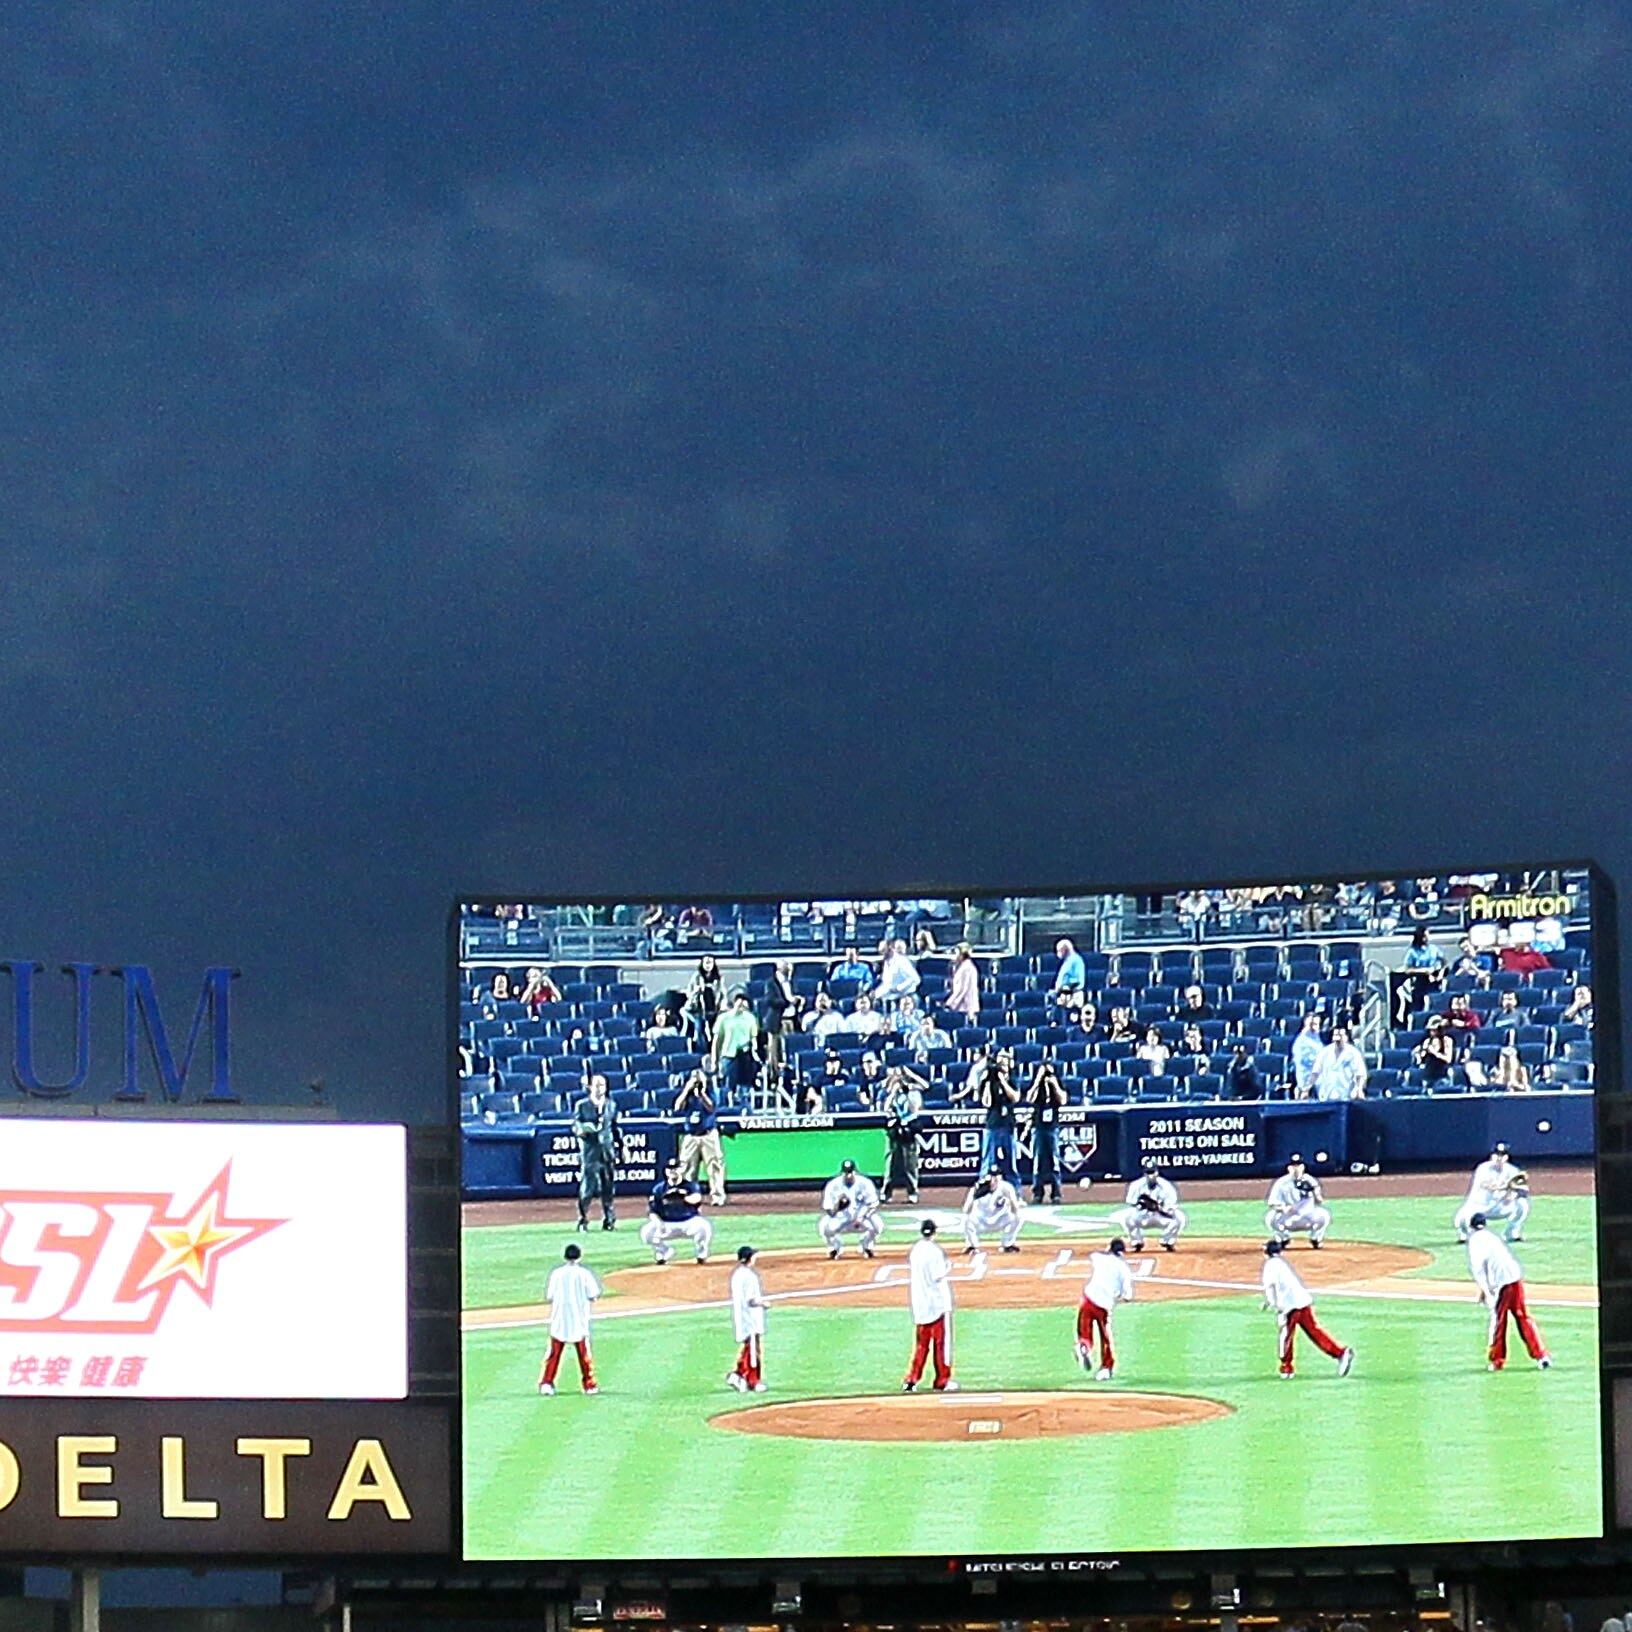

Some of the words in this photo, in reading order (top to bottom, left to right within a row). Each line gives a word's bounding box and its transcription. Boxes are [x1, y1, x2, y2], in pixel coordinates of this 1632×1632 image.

[1471, 893, 1571, 919] Armitron
[1150, 1118, 1181, 1133] 2011
[1186, 1116, 1244, 1131] SEASON
[917, 1132, 980, 1154] MLB
[1140, 1136, 1193, 1150] TICKETS
[1198, 1135, 1217, 1147] ON
[1221, 1133, 1256, 1147] SALE
